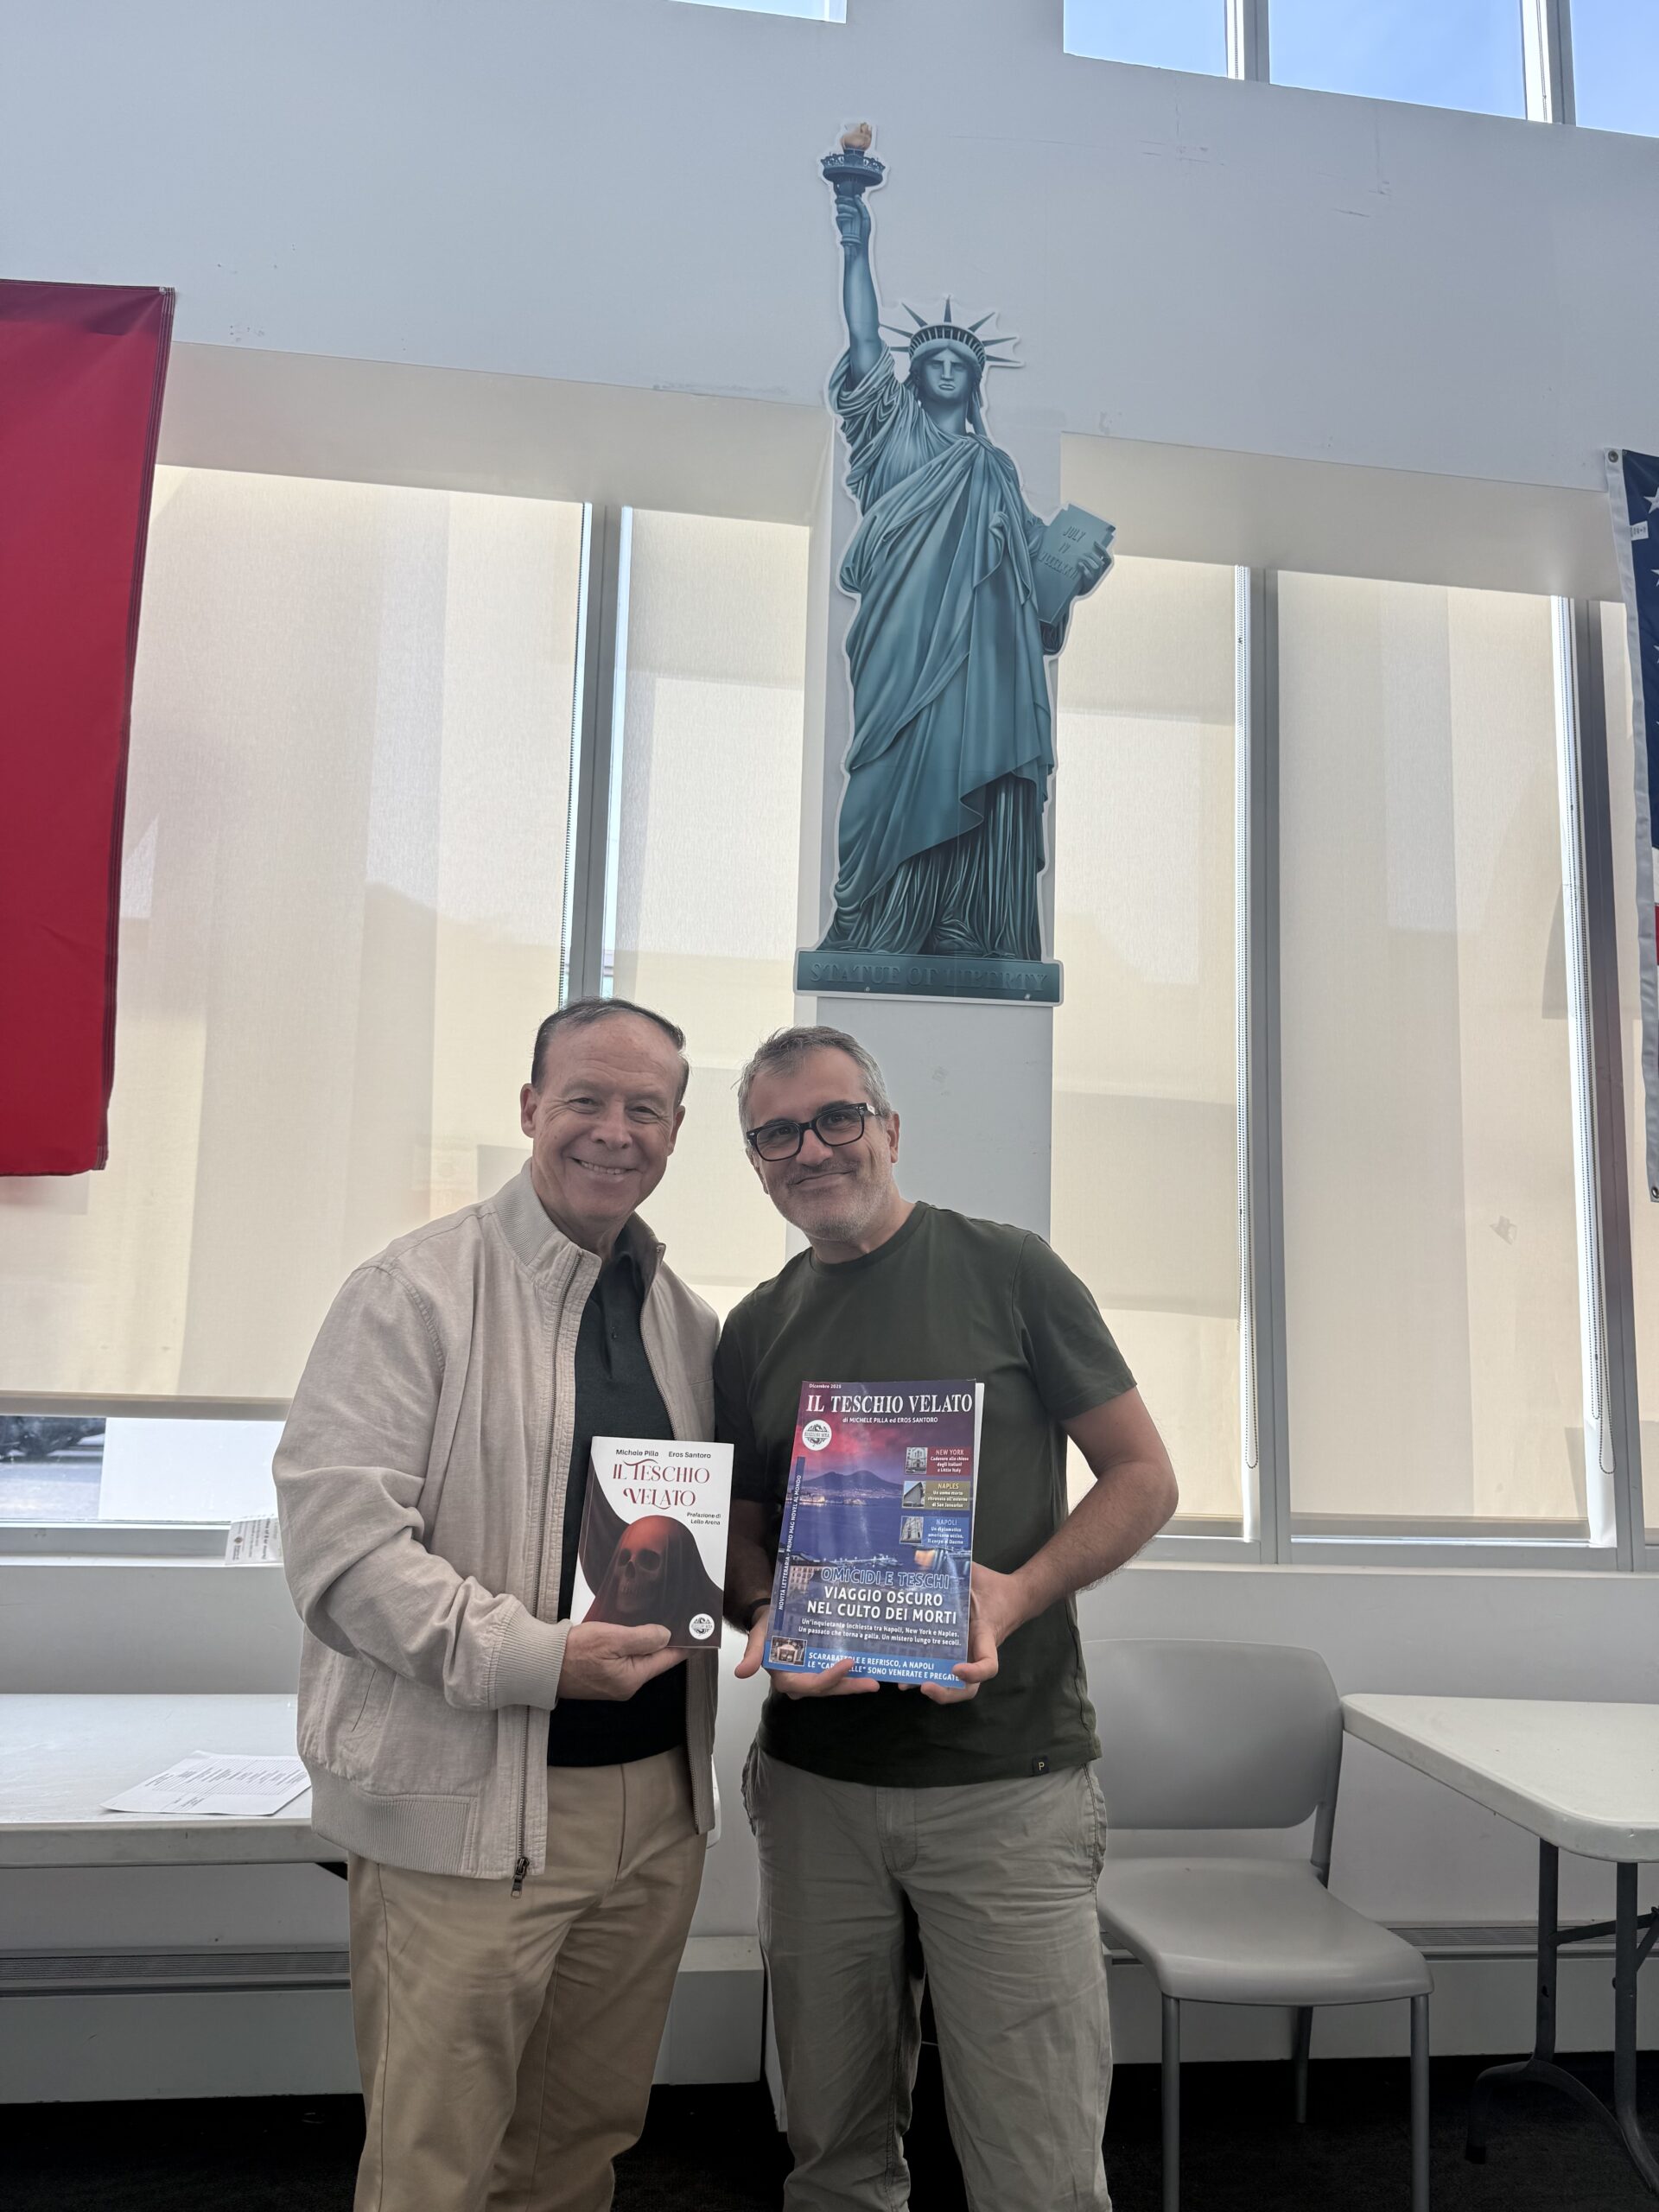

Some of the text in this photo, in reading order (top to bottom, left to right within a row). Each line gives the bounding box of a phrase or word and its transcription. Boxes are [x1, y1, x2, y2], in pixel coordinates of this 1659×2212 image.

[1063, 525, 1086, 543] JULY
[810, 963, 1048, 991] STATUE OF LIBERTY
[805, 1394, 973, 1414] IL TESCHIO VELATO
[613, 1459, 710, 1484] IL TESCHIO
[623, 1488, 696, 1510] VELATO
[780, 1556, 790, 1588] LETTERARIA
[821, 1567, 950, 1590] OMICIDI E TESCHI
[824, 1586, 943, 1606] VIAGGIO OSCURO
[807, 1600, 956, 1624] NEL CULTO DEI MORTI
[802, 1618, 845, 1628] Un'inquietante
[847, 1623, 873, 1631] inchiesta
[883, 1625, 904, 1634] Napoli,
[938, 1630, 959, 1638] Naples.
[914, 1636, 931, 1645] lungo
[868, 1657, 900, 1668] REFRISCO,
[909, 1662, 935, 1670] NAPOLI
[888, 1668, 923, 1678] VENERATE
[1039, 1761, 1045, 1771] P
